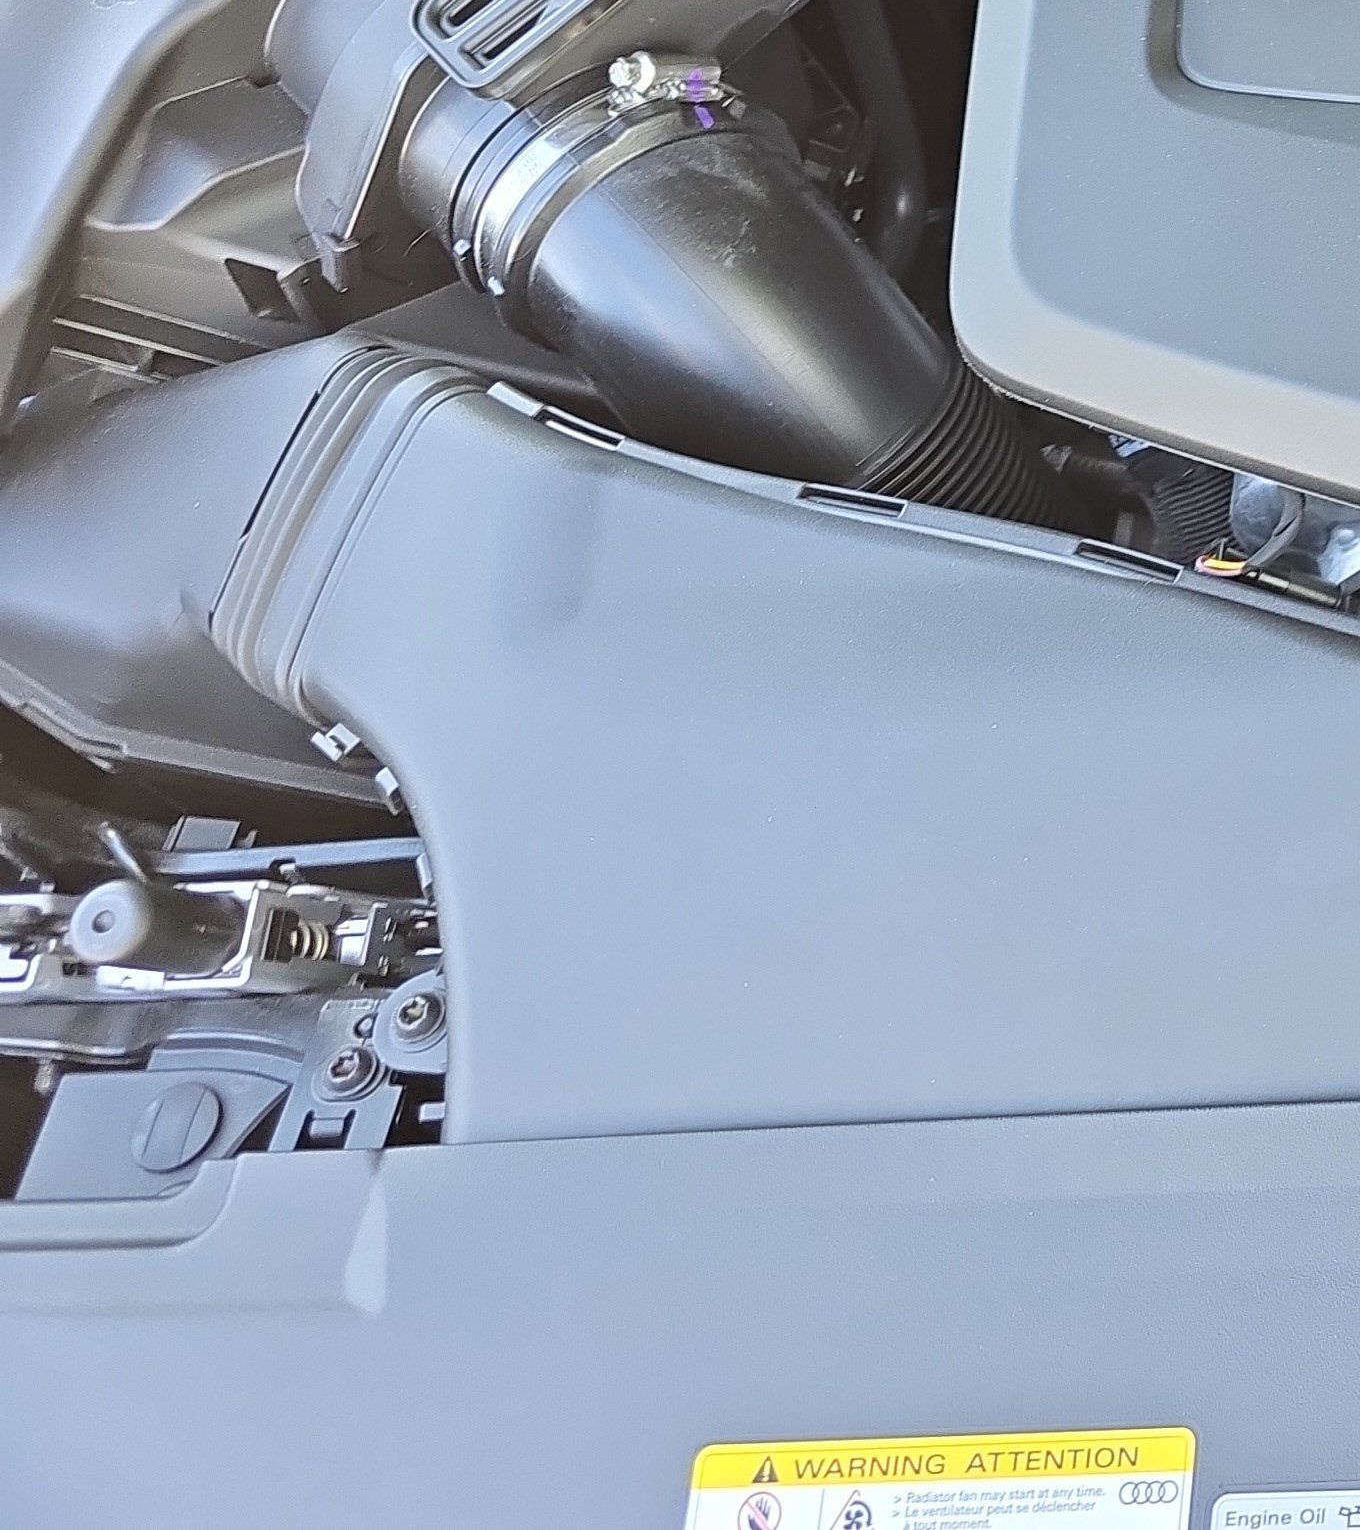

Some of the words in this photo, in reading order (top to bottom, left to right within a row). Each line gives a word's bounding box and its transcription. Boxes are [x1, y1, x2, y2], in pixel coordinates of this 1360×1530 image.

[794, 1454, 946, 1480] WARNING
[966, 1446, 1139, 1474] ATTENTION
[906, 1490, 957, 1504] Radiator
[958, 1489, 977, 1502] fan
[979, 1490, 1005, 1503] may
[1009, 1488, 1035, 1500] start
[1038, 1488, 1050, 1499] at
[1051, 1488, 1073, 1500] any
[1076, 1485, 1105, 1498] time.
[905, 1506, 919, 1518] Le
[921, 1504, 984, 1517] ventilateur
[986, 1503, 1014, 1515] peut
[1016, 1504, 1029, 1513] se
[1224, 1509, 1292, 1530] Engine
[1299, 1508, 1326, 1525] Oil
